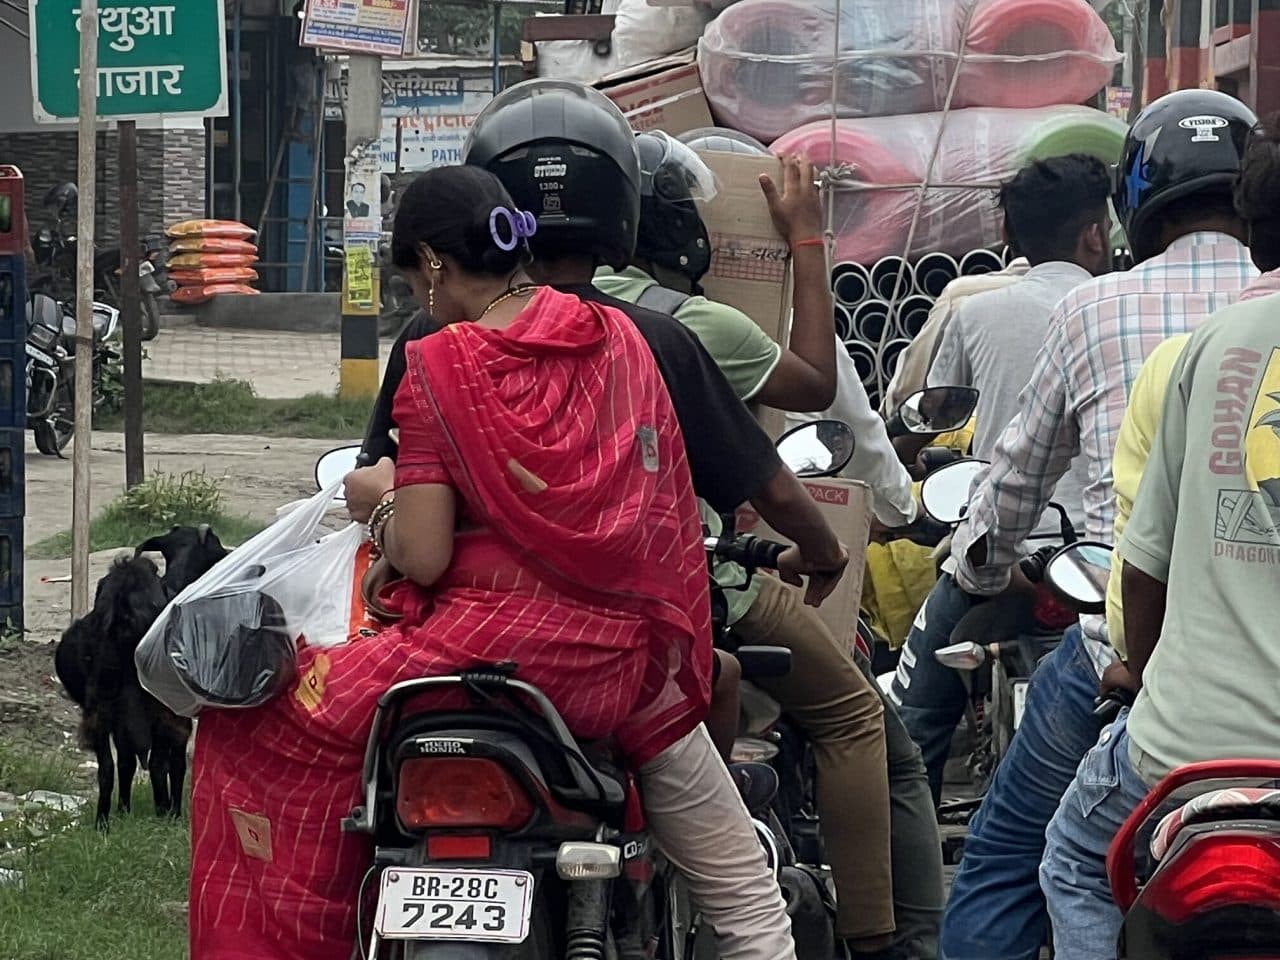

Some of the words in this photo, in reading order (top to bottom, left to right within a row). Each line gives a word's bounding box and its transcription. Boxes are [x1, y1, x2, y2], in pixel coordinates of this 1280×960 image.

[1208, 347, 1263, 476] GOHAN
[809, 486, 844, 502] PACK
[1213, 541, 1279, 564] DRAGON
[411, 875, 499, 900] BR-28C
[402, 903, 507, 932] 7243
